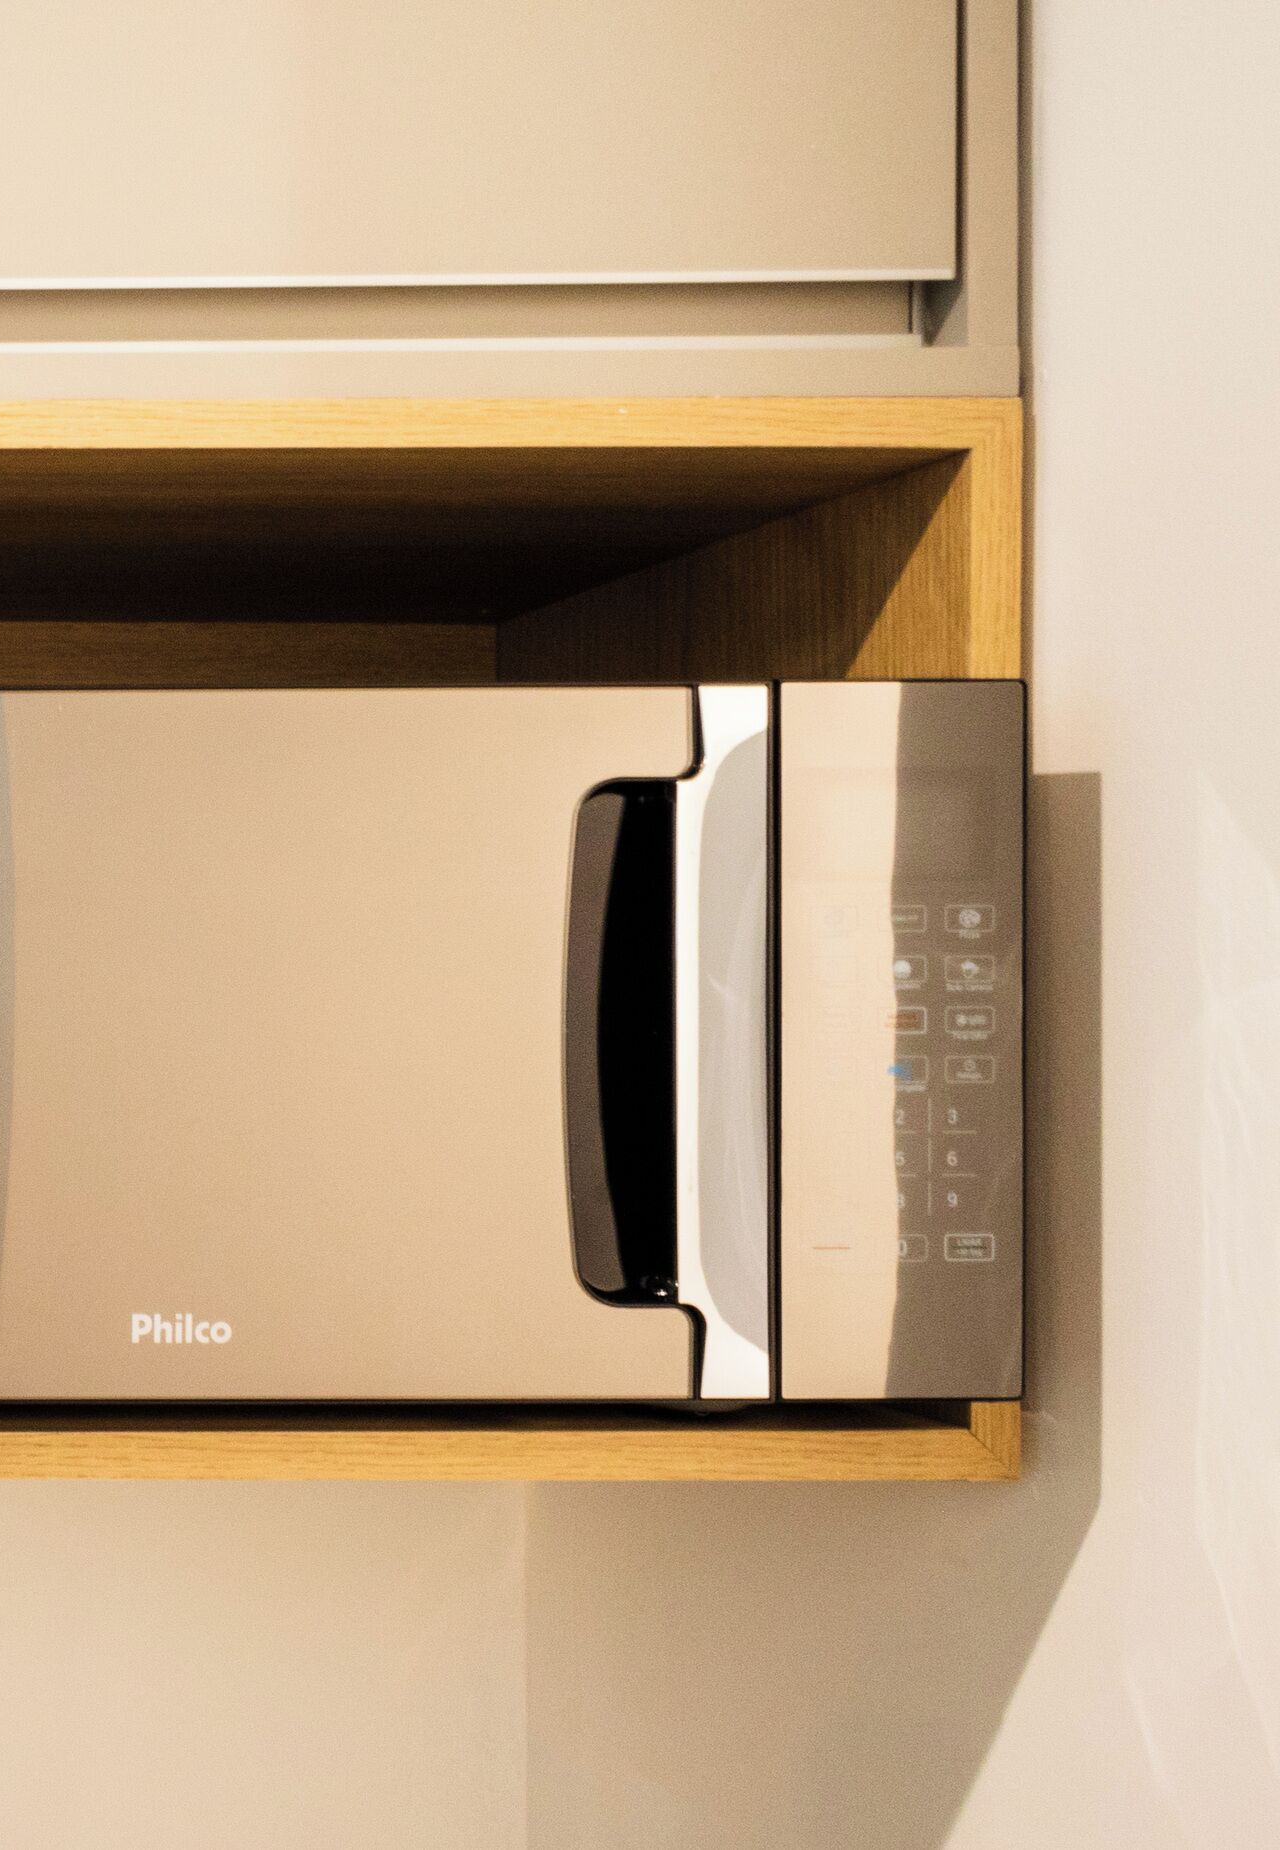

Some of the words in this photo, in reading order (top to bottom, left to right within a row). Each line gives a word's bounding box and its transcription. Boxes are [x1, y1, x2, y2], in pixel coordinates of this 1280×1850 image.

[947, 1108, 958, 1125] 3
[947, 1151, 958, 1167] 6
[947, 1191, 958, 1208] 9
[131, 1312, 233, 1344] Philco
